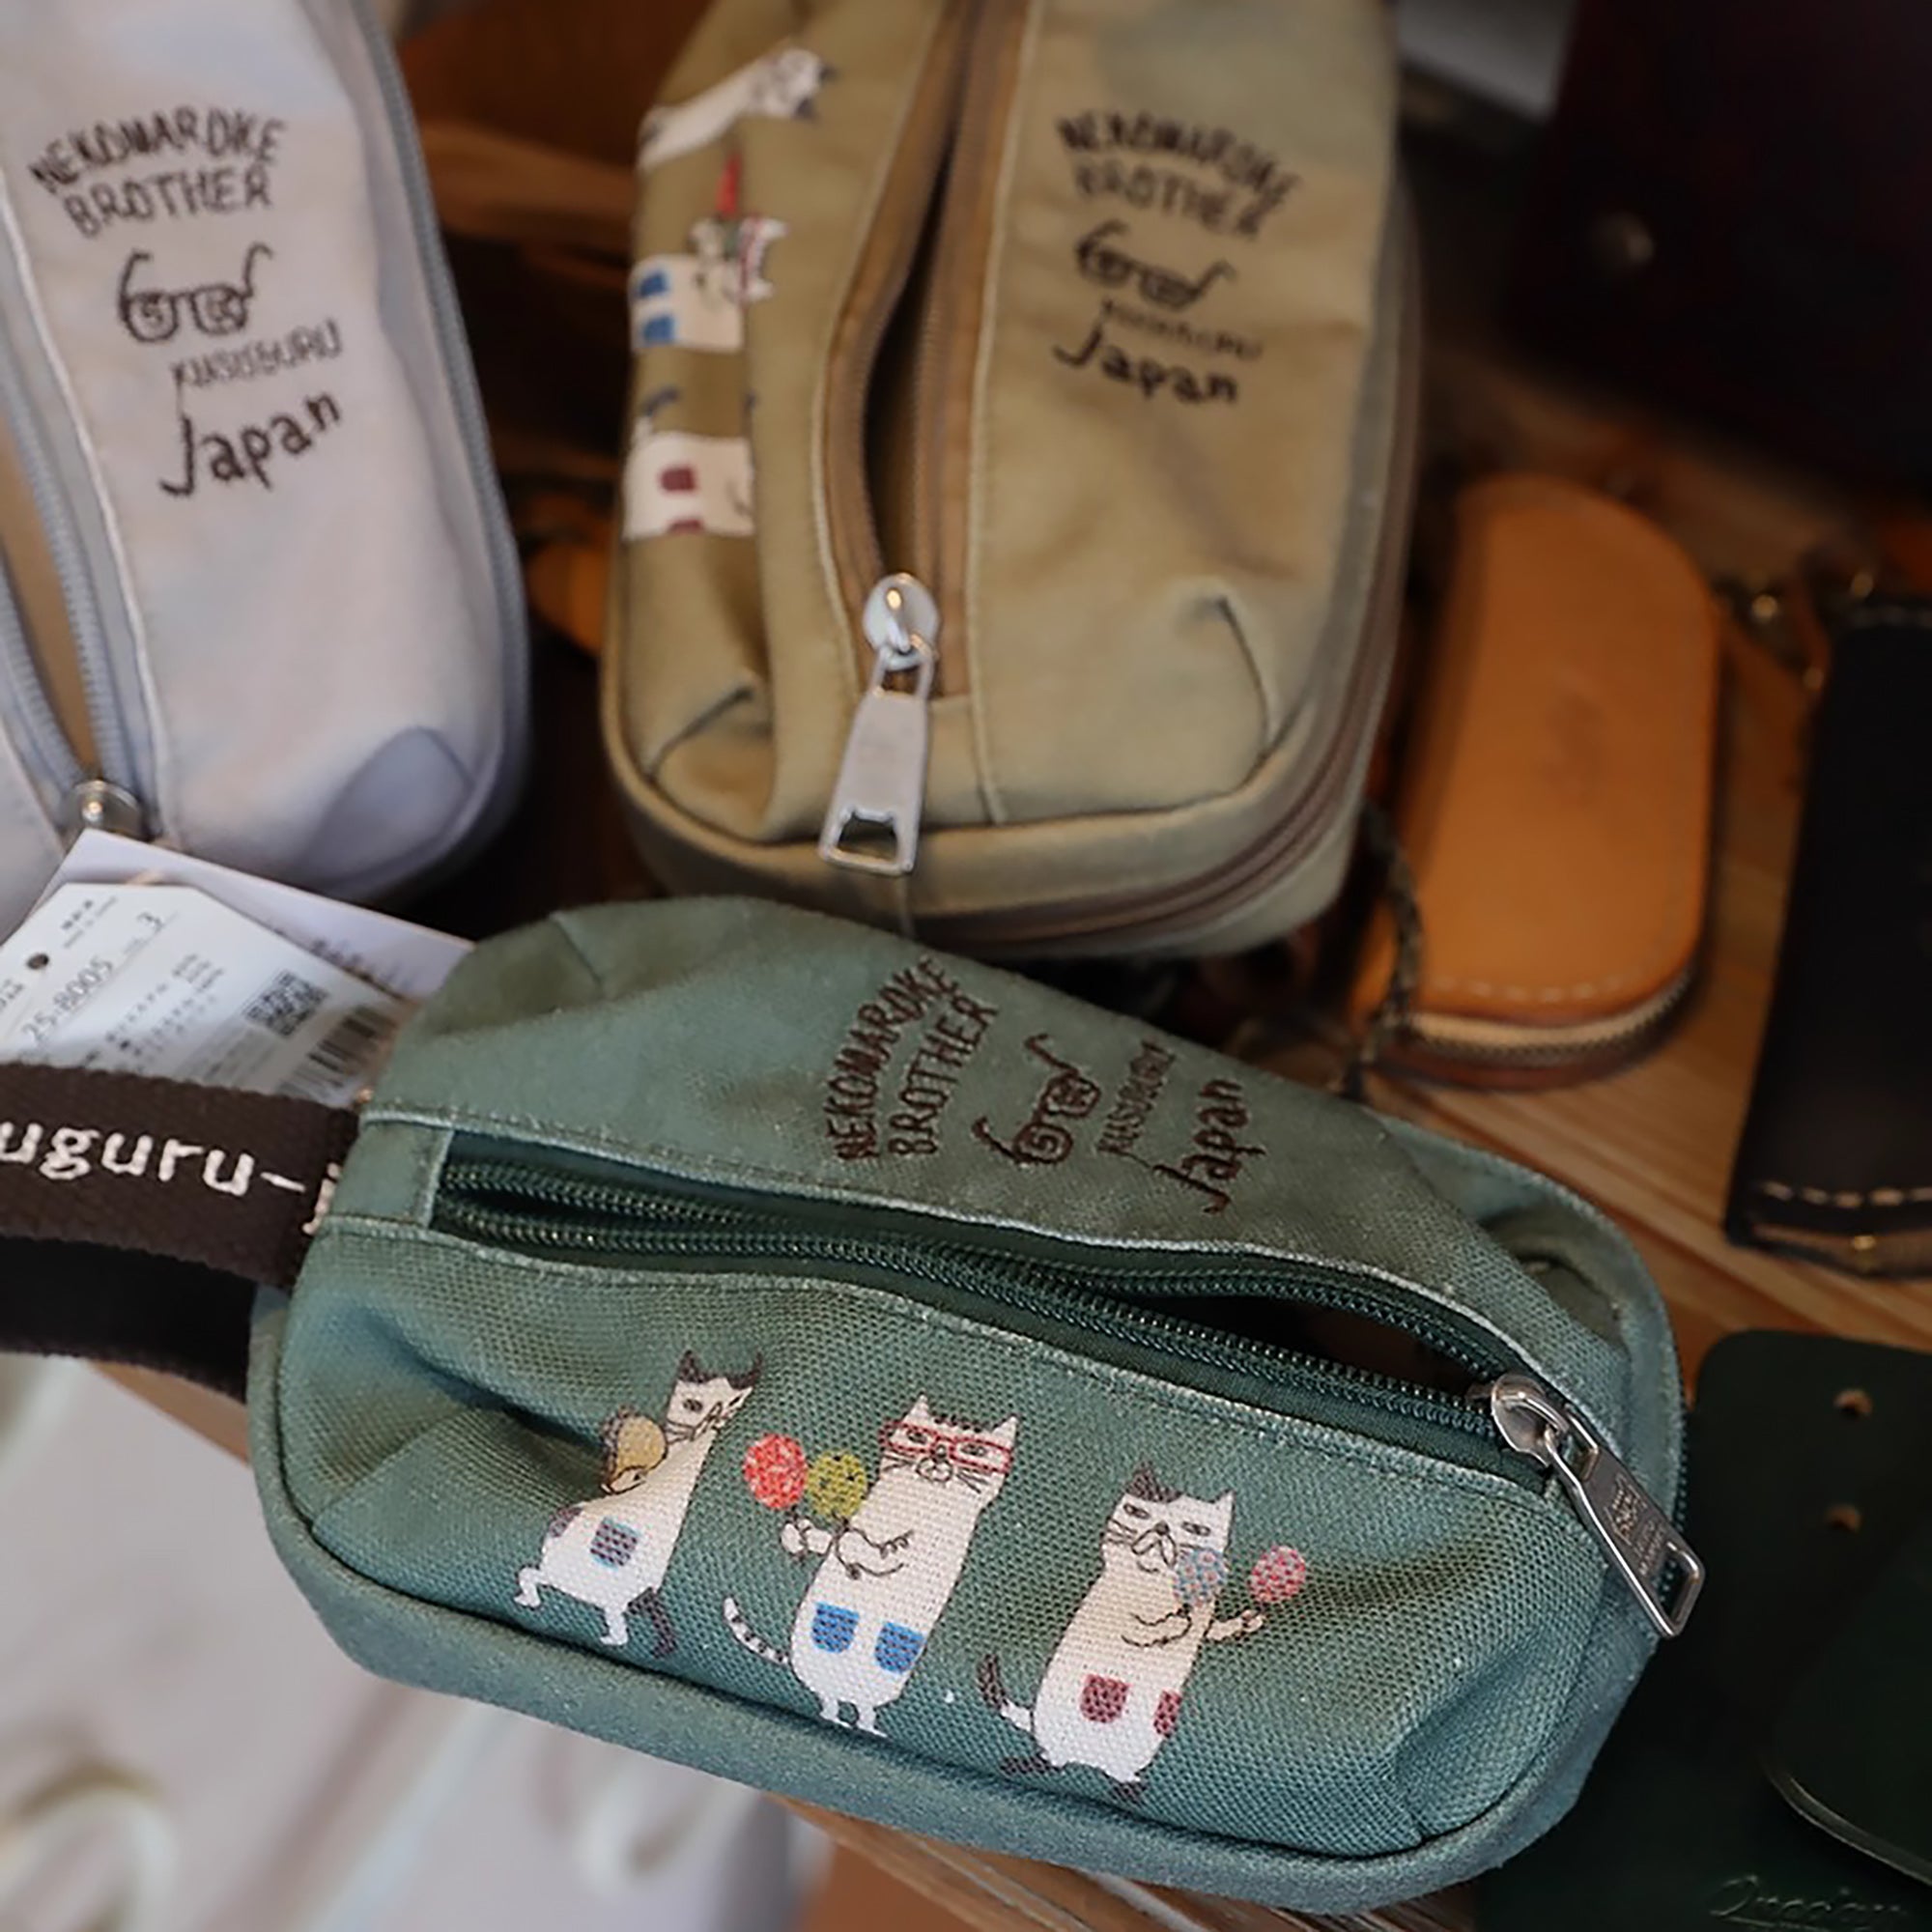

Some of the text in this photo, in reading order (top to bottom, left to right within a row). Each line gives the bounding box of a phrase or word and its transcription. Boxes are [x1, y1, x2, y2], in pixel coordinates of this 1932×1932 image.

[64, 164, 272, 238] BROTHER
[1052, 319, 1237, 404] Japan
[157, 391, 341, 497] Japan
[889, 996, 1000, 1156] BROTHER
[1153, 1079, 1266, 1214] Japan
